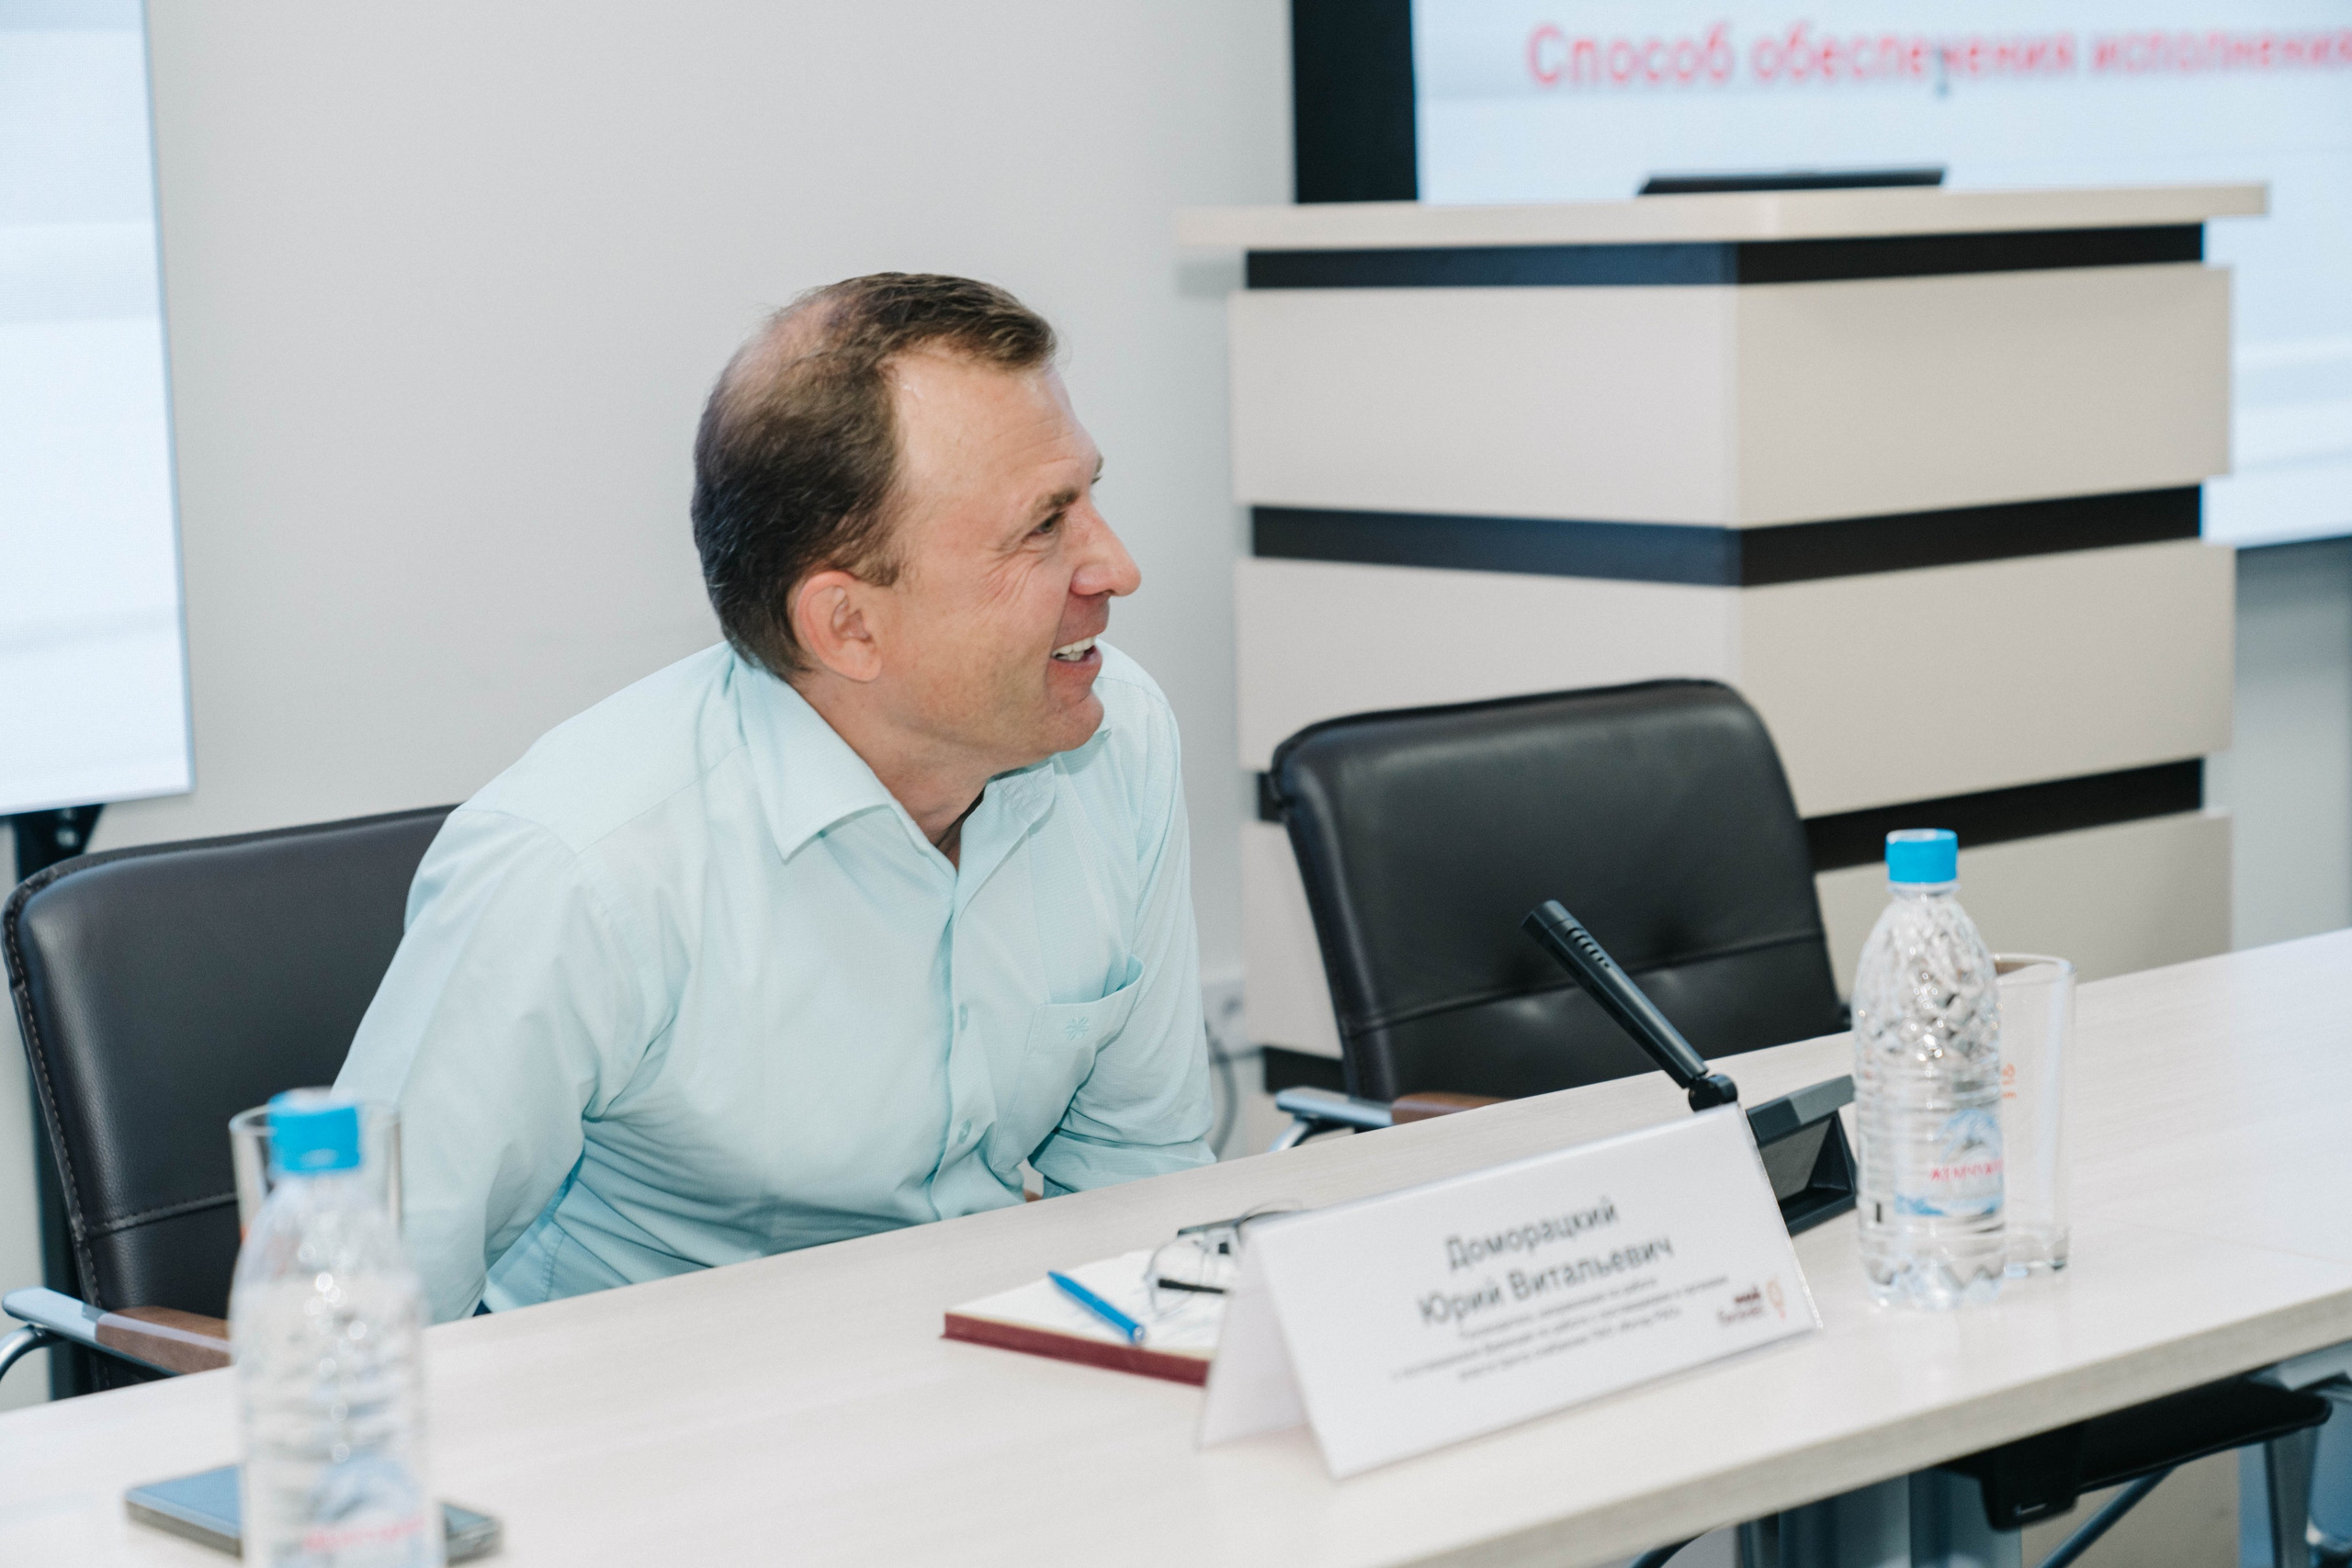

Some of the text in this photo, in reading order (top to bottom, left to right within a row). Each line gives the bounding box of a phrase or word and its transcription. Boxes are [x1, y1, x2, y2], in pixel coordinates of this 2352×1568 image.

[1526, 21, 1734, 87] Способ
[1751, 22, 2075, 83] обеспечения
[1445, 1196, 1620, 1271] Доморацкий
[1419, 1277, 1503, 1326] Юрий
[1507, 1235, 1675, 1302] Витальевич
